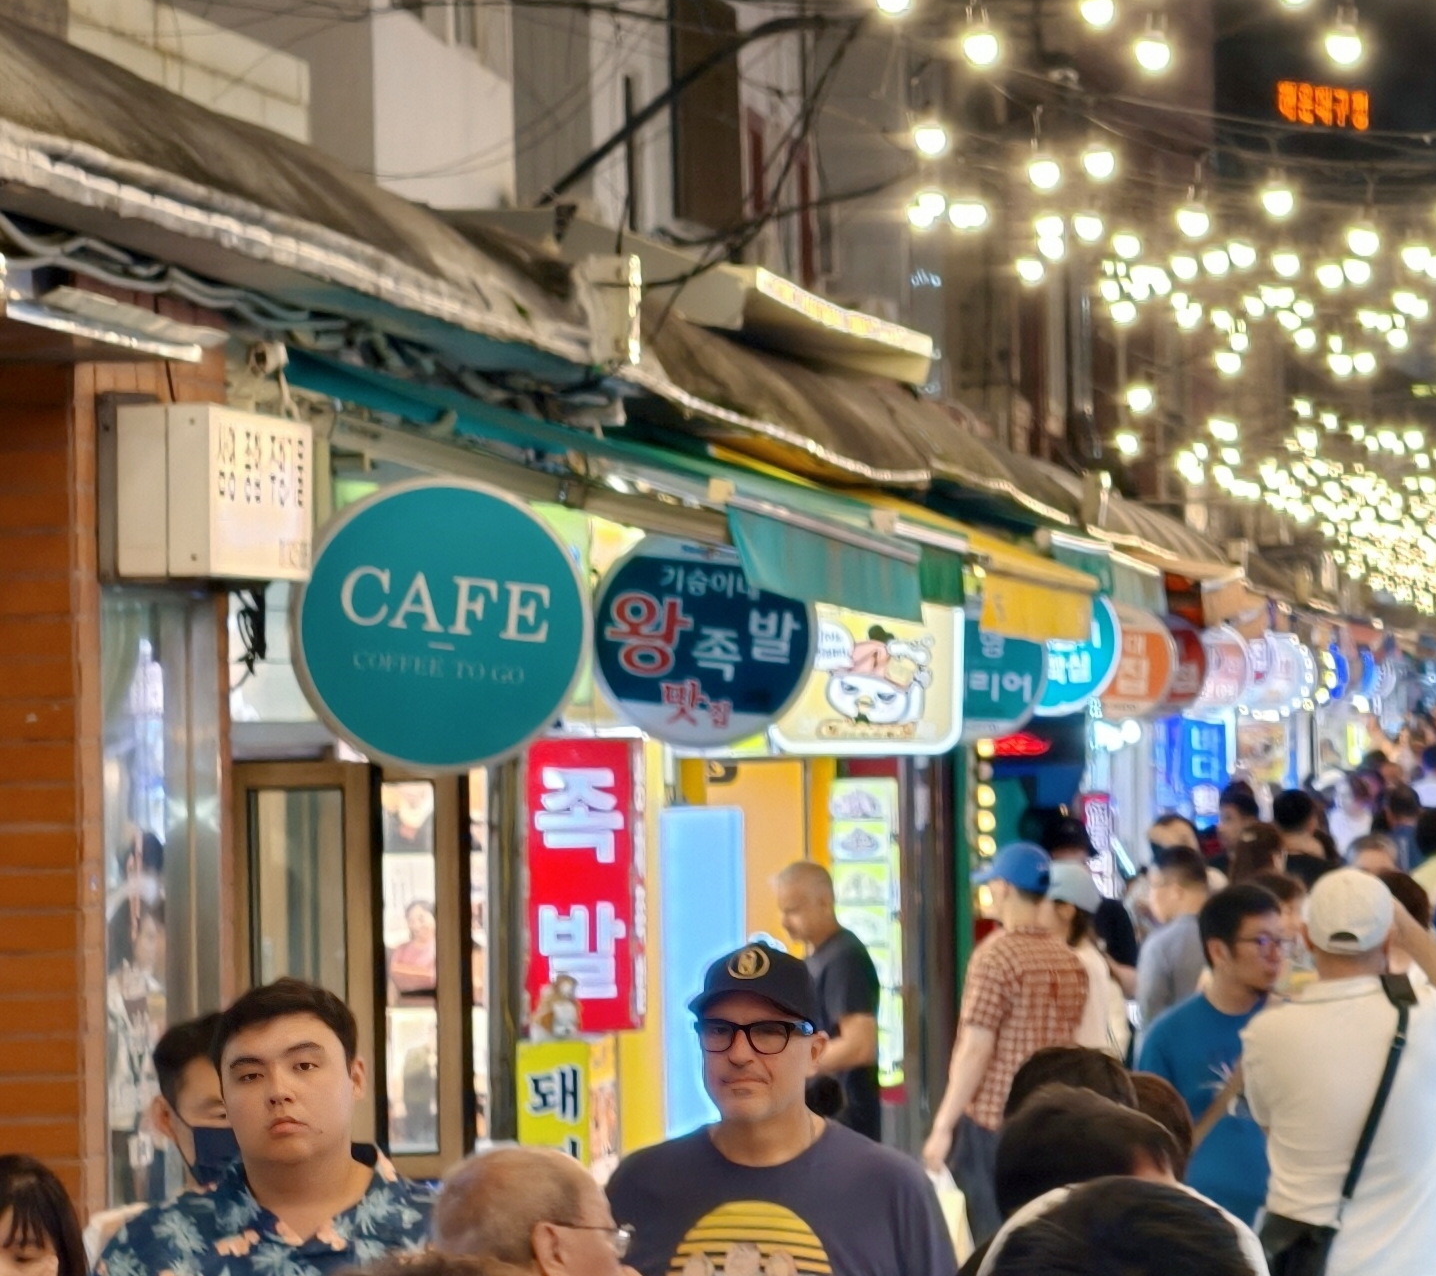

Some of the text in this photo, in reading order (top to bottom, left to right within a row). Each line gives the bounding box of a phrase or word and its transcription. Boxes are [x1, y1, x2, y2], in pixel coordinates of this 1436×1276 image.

[341, 565, 550, 643] CAFE
[353, 649, 445, 678] COFFEE
[534, 766, 626, 1000] 족발
